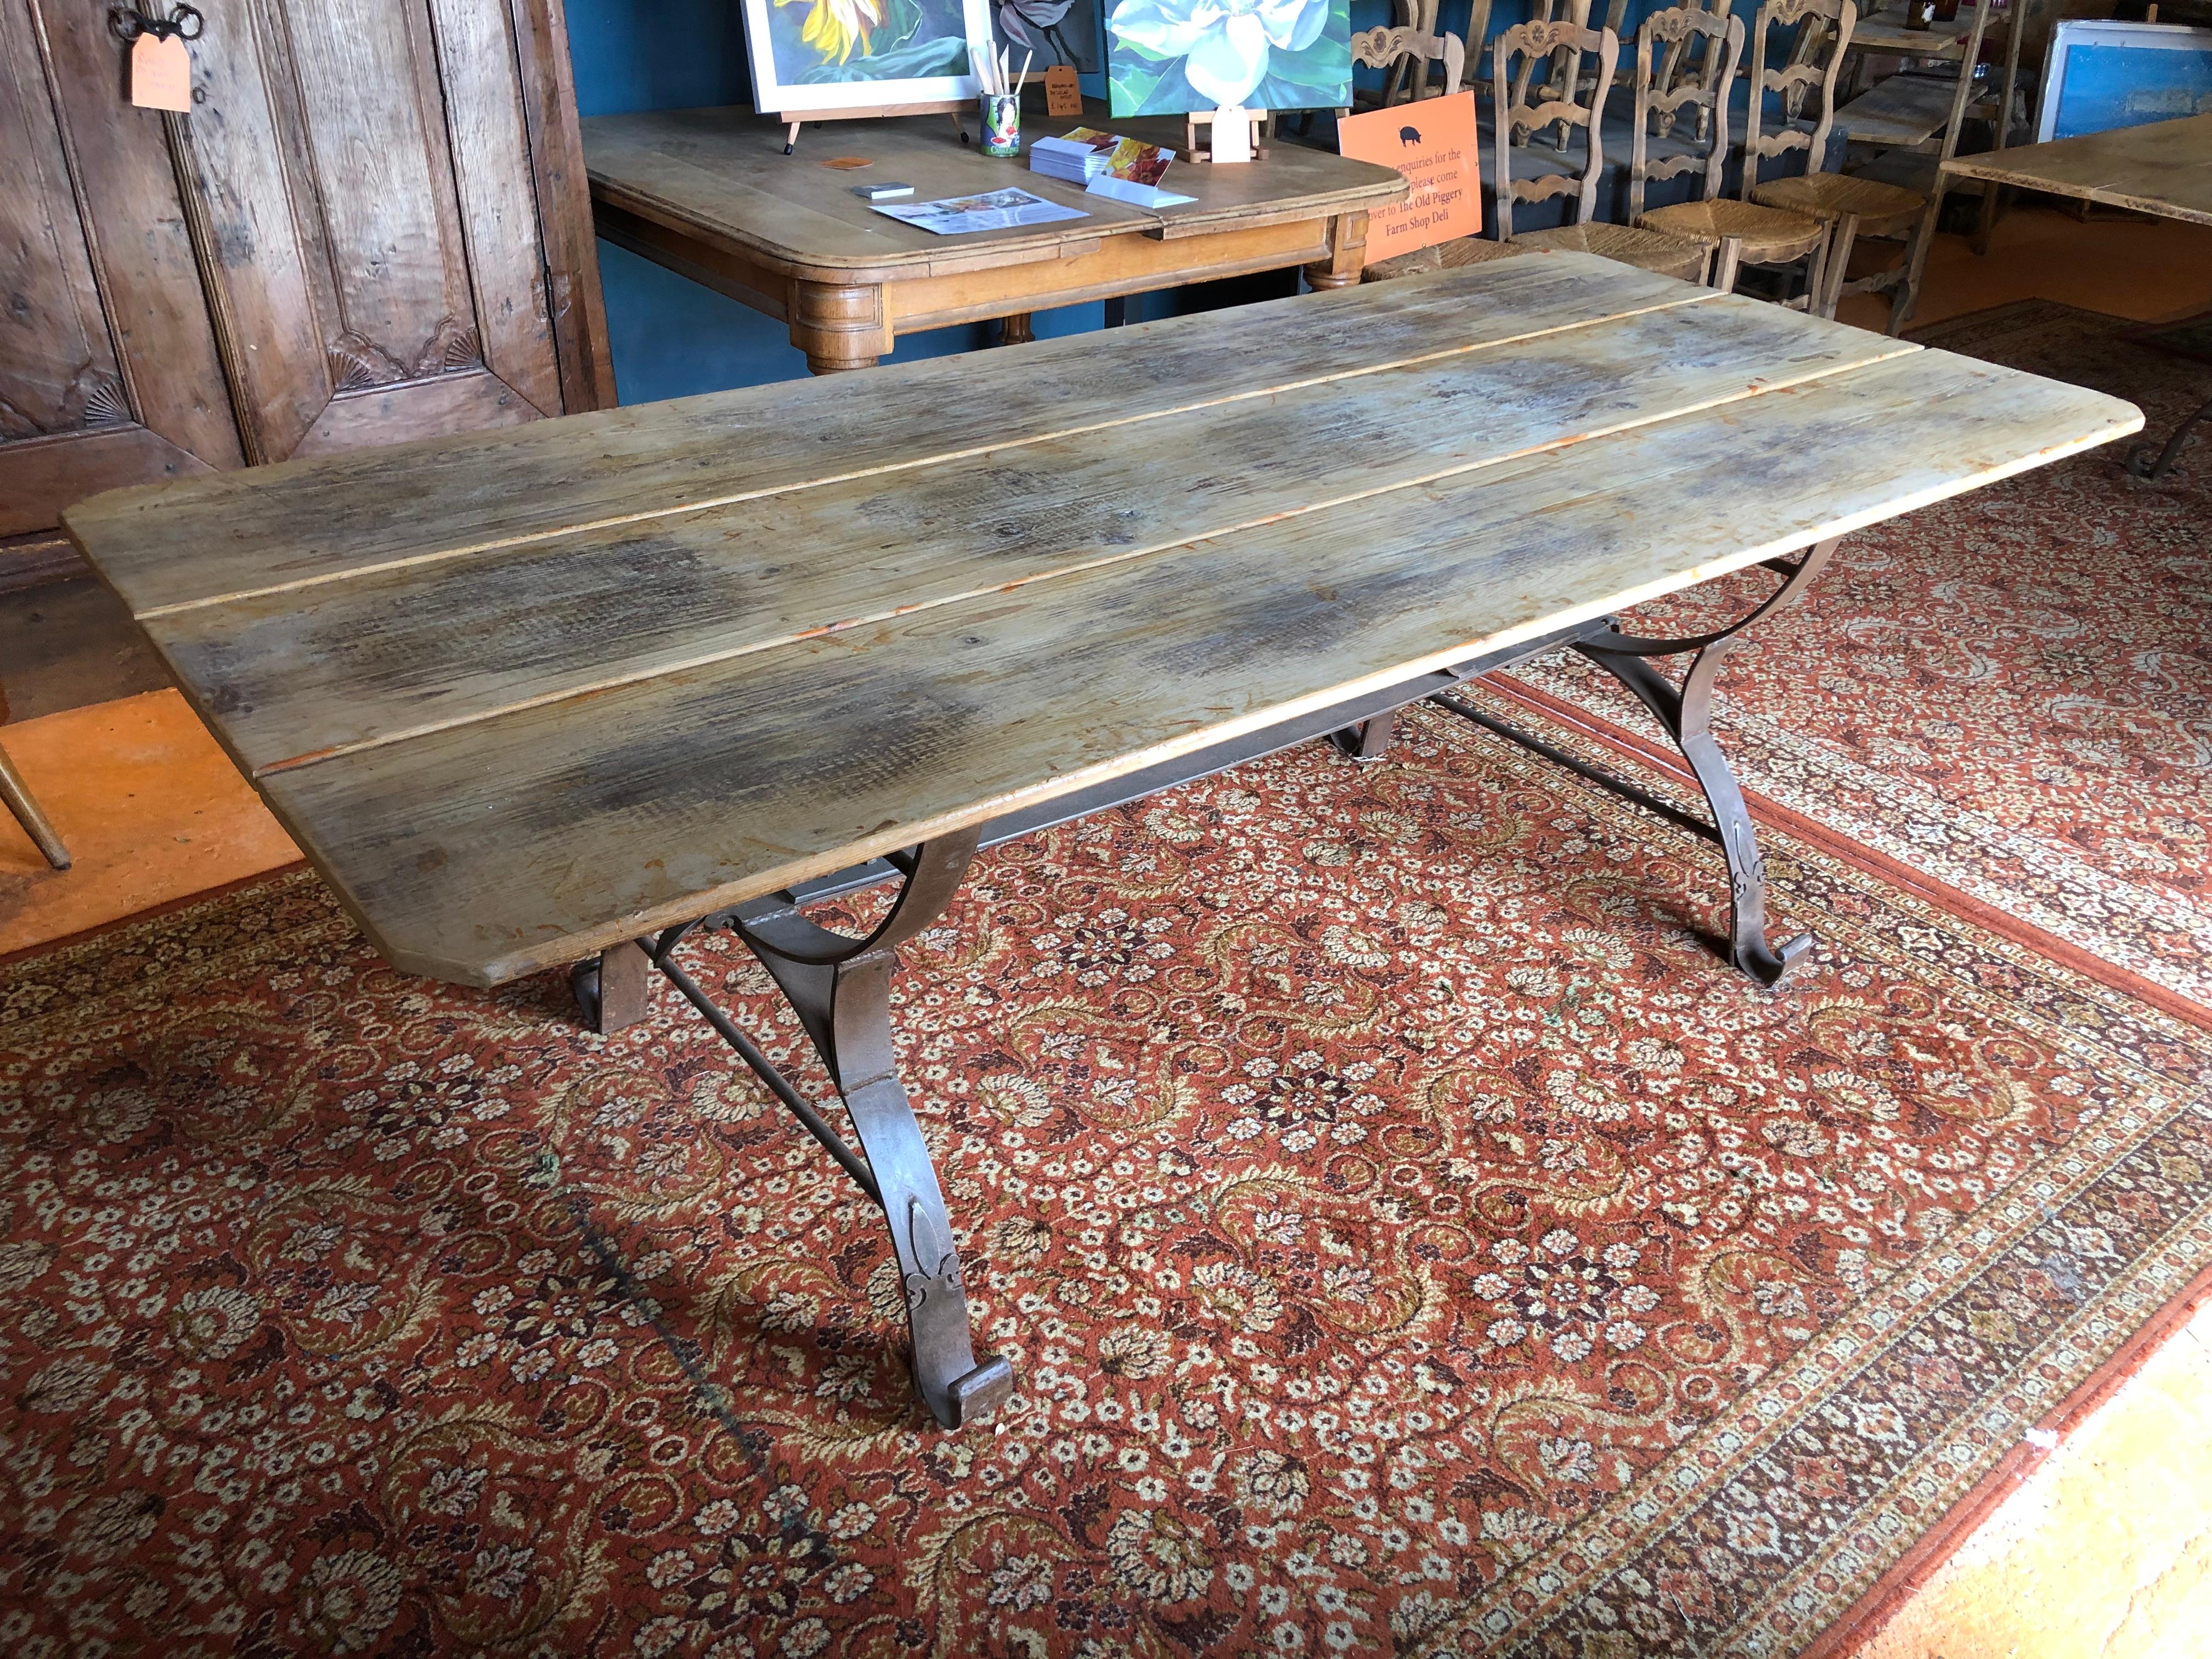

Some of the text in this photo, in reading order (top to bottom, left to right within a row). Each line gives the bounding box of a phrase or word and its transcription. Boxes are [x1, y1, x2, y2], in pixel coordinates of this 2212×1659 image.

[1435, 151, 1446, 164] for
[1448, 148, 1461, 161] the
[1410, 170, 1458, 194] please come
[1388, 206, 1396, 216] to
[1400, 201, 1413, 212] The
[1415, 194, 1430, 208] Old
[1433, 188, 1463, 205] Piggery
[1386, 208, 1449, 236] Farm Shop Deli
